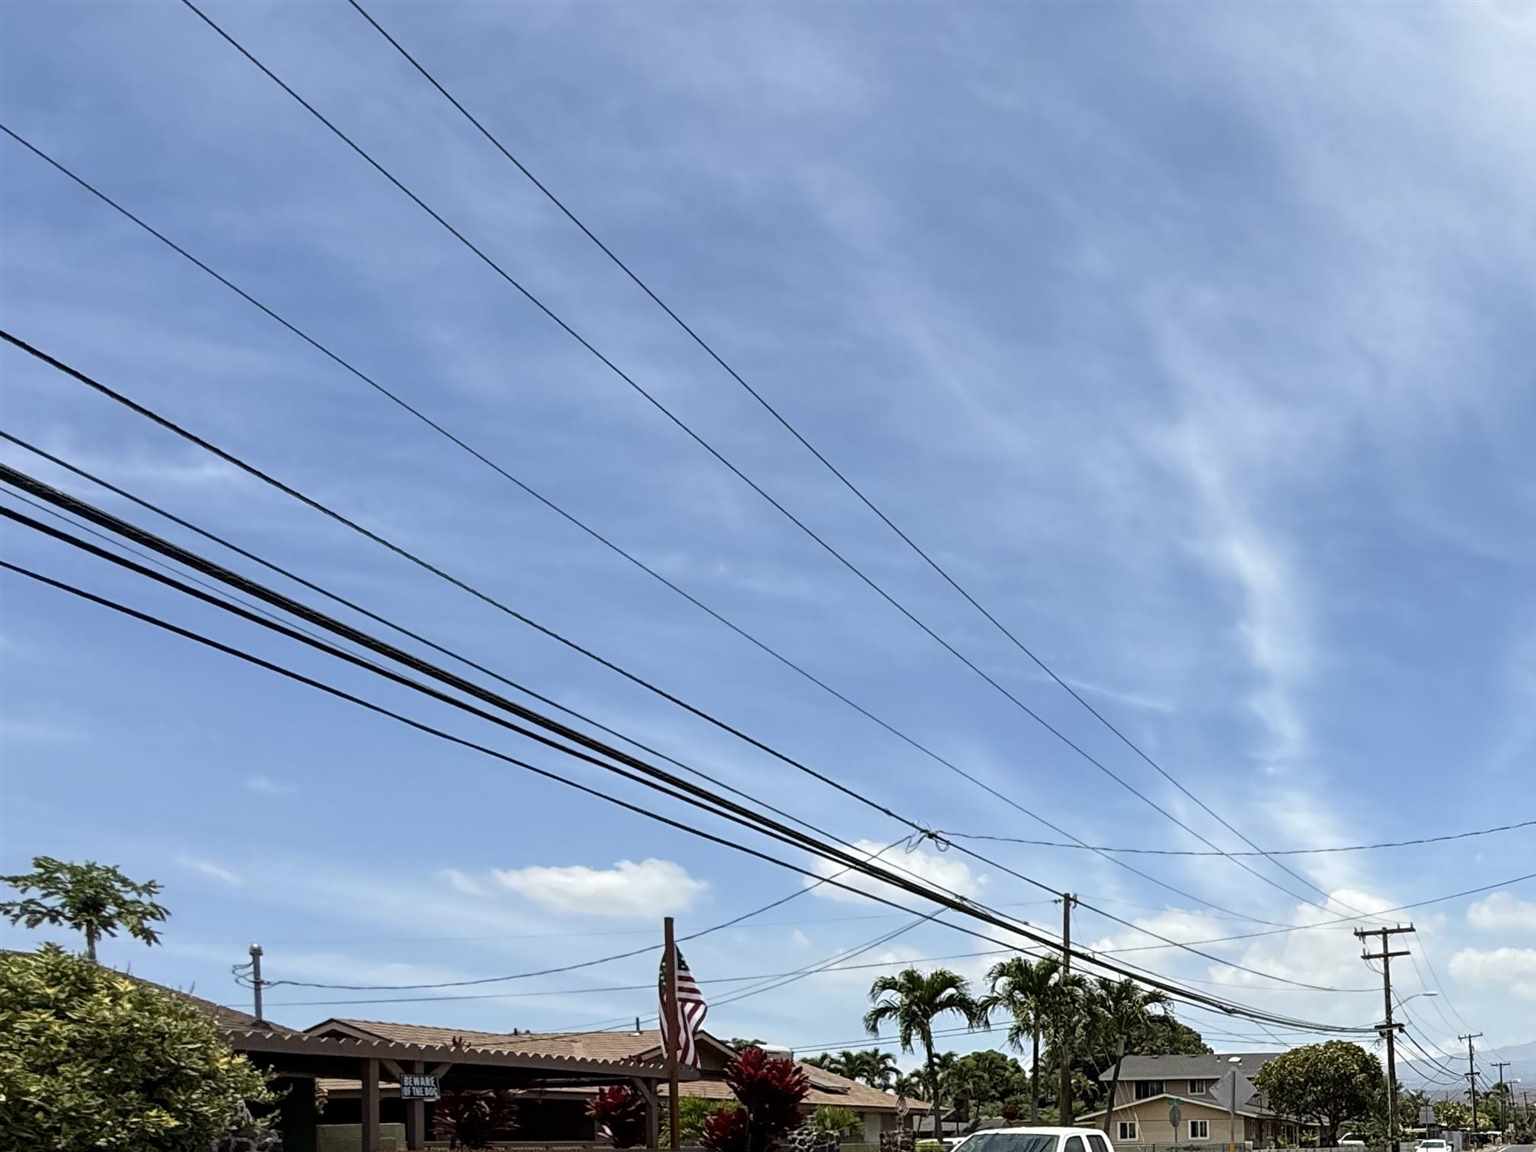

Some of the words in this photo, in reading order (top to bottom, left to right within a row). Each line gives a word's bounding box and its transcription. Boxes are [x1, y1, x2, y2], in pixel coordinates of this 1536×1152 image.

[403, 1076, 435, 1086] BEWARE
[403, 1086, 411, 1096] OF
[412, 1086, 424, 1096] THE
